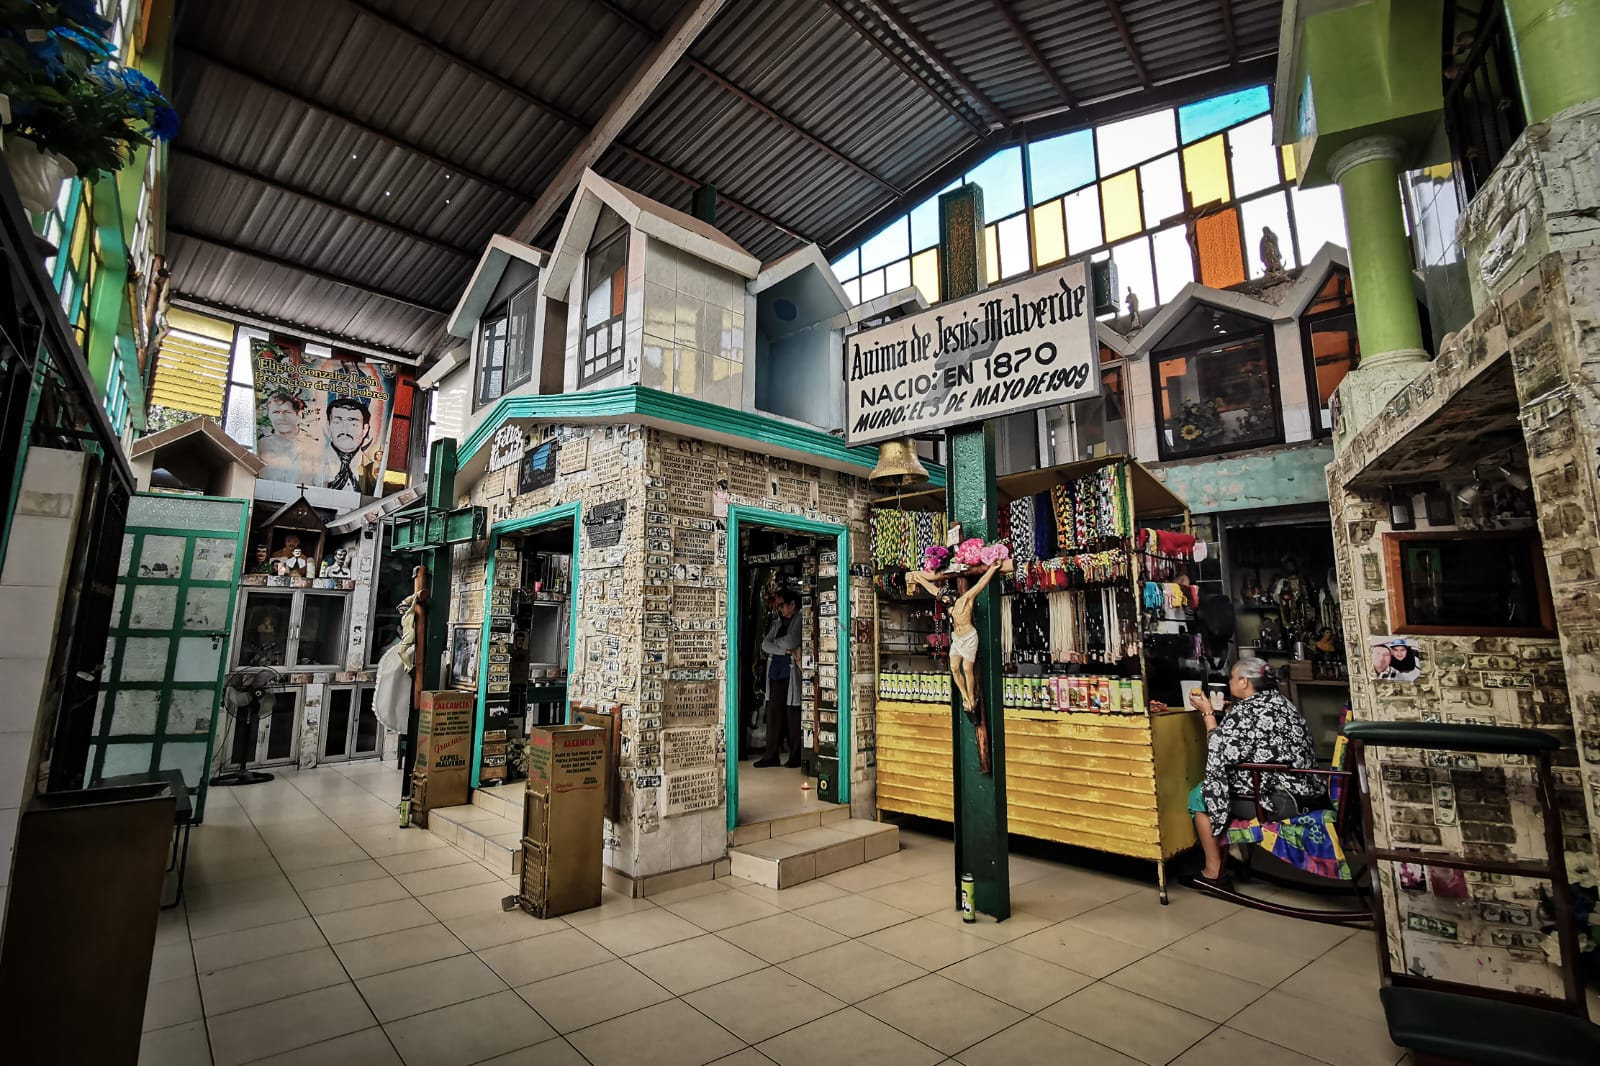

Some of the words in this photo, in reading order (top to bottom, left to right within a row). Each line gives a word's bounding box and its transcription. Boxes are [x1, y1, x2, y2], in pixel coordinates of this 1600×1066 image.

[850, 340, 907, 381] Anima
[911, 324, 931, 362] de
[978, 277, 1086, 344] Malverde
[255, 371, 312, 389] Protector
[314, 380, 330, 391] de
[331, 382, 348, 395] los
[351, 388, 389, 400] pobres
[259, 357, 296, 375] Eligio
[860, 371, 938, 408] NACIO:
[944, 361, 974, 388] EN
[984, 341, 1057, 381] 1870
[908, 401, 926, 421] EL
[929, 397, 942, 417] 3
[943, 391, 968, 415] DE
[970, 374, 1024, 408] MAYO
[1022, 371, 1049, 398] DE
[1045, 362, 1090, 393] 1909
[564, 738, 595, 747] ALCANCIA
